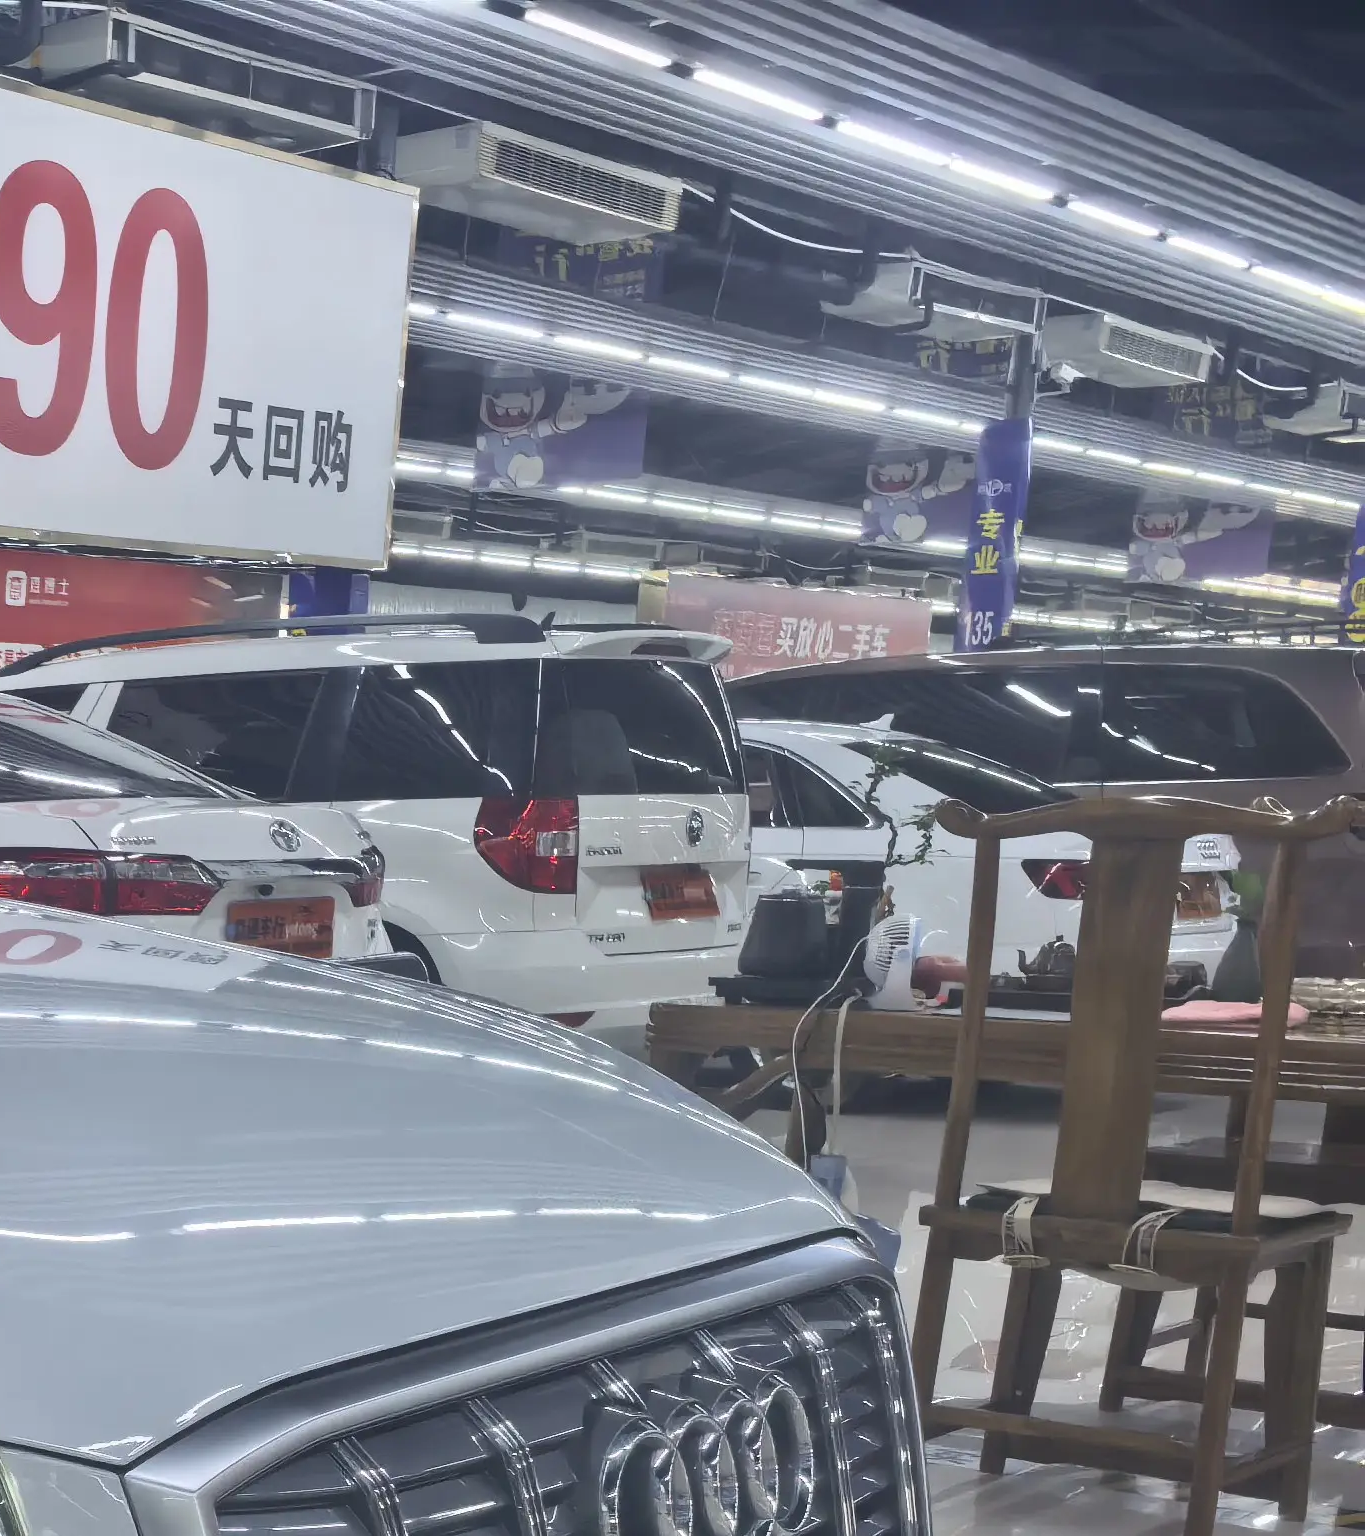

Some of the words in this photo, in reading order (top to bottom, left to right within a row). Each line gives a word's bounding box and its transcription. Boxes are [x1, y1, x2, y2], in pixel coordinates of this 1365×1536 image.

[209, 397, 353, 493] 天回购
[970, 509, 1005, 575] 专业
[774, 616, 891, 661] 买放心二手车
[964, 611, 995, 646] 135
